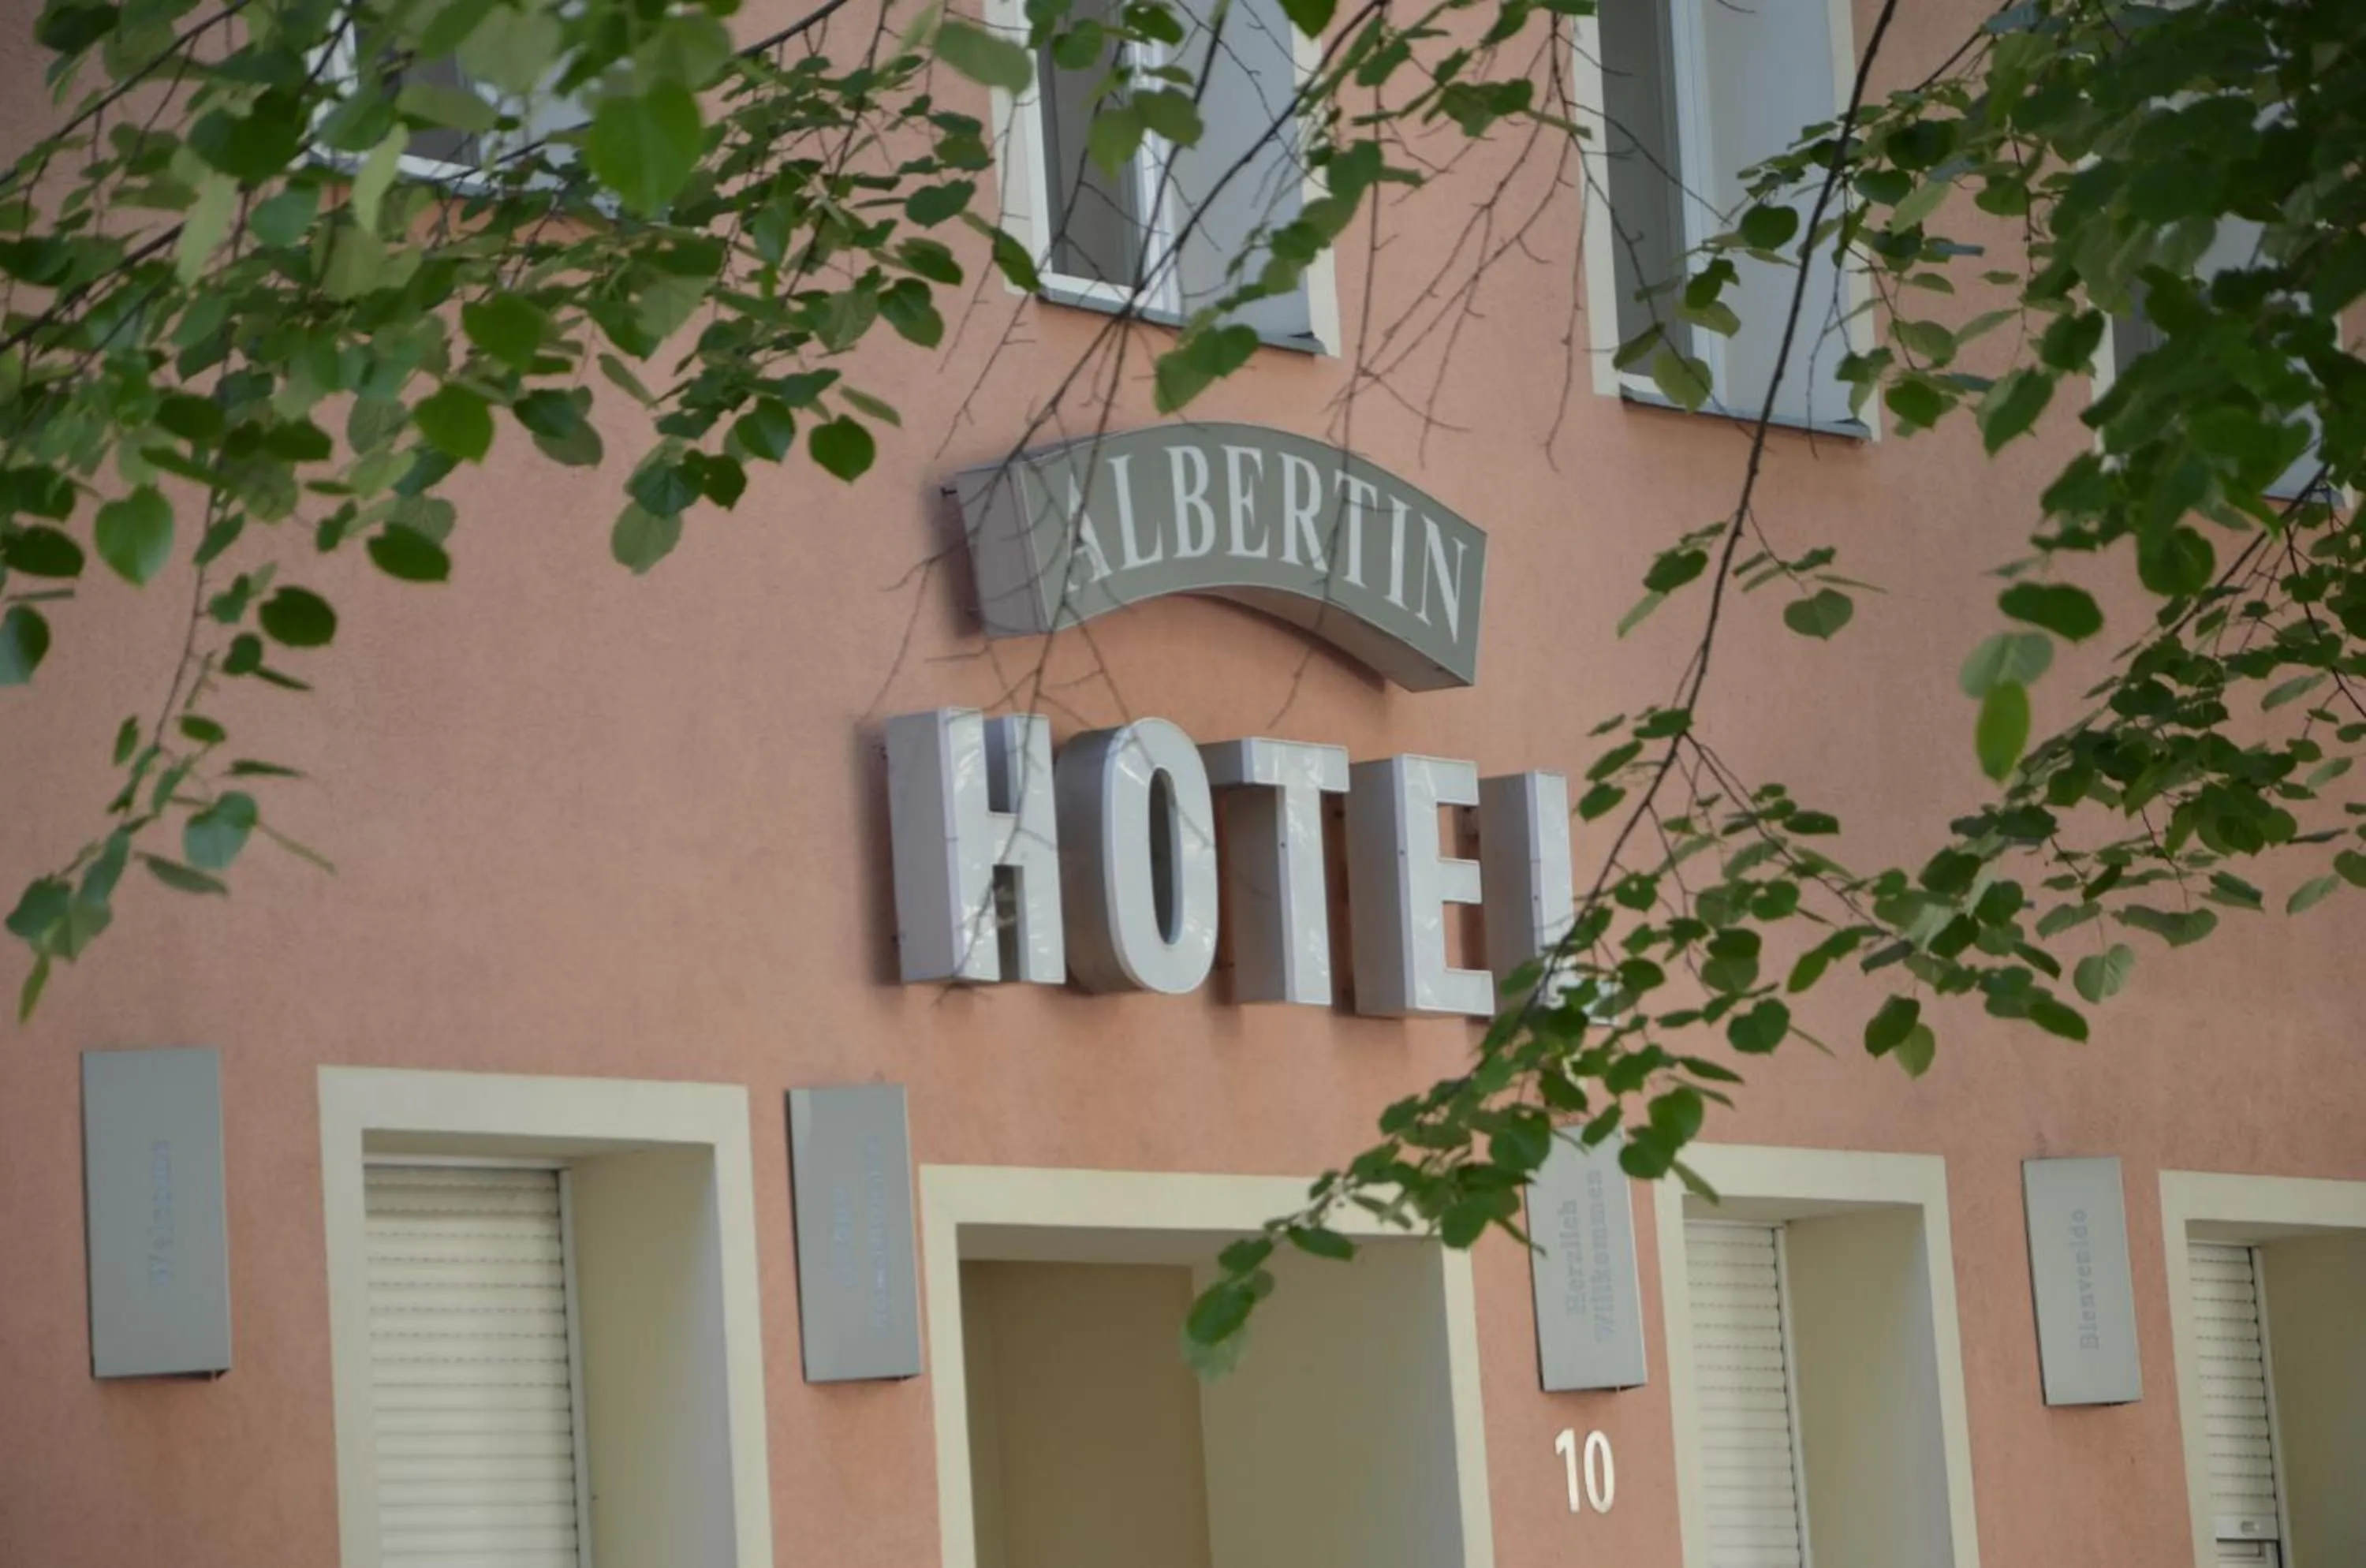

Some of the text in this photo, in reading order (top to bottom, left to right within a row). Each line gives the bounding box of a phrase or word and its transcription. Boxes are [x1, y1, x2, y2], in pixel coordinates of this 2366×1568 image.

[1065, 443, 1469, 645] ALBERTIN
[935, 706, 1622, 1027] HOTEL
[1558, 1199, 1586, 1317] Herzlich
[1587, 1169, 1615, 1342] Willkommen
[2069, 1208, 2099, 1350] Bienvenido
[1554, 1428, 1615, 1514] 10
